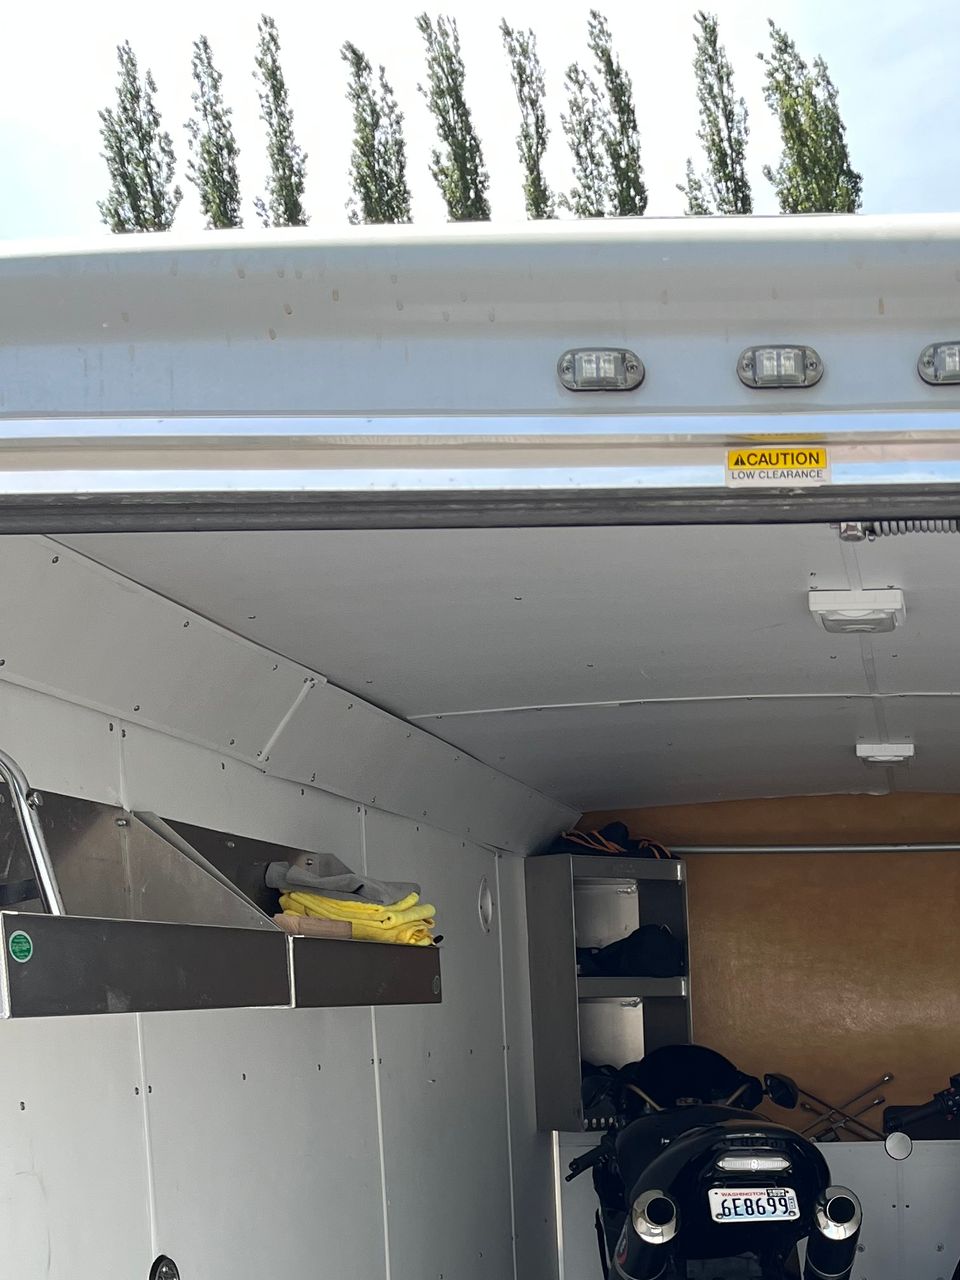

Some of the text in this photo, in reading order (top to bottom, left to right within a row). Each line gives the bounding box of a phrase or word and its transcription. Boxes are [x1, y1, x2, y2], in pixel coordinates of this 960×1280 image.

[746, 452, 820, 466] CAUTION
[731, 470, 823, 480] LOW CLEARANCE
[721, 1198, 789, 1217] 6E8699
